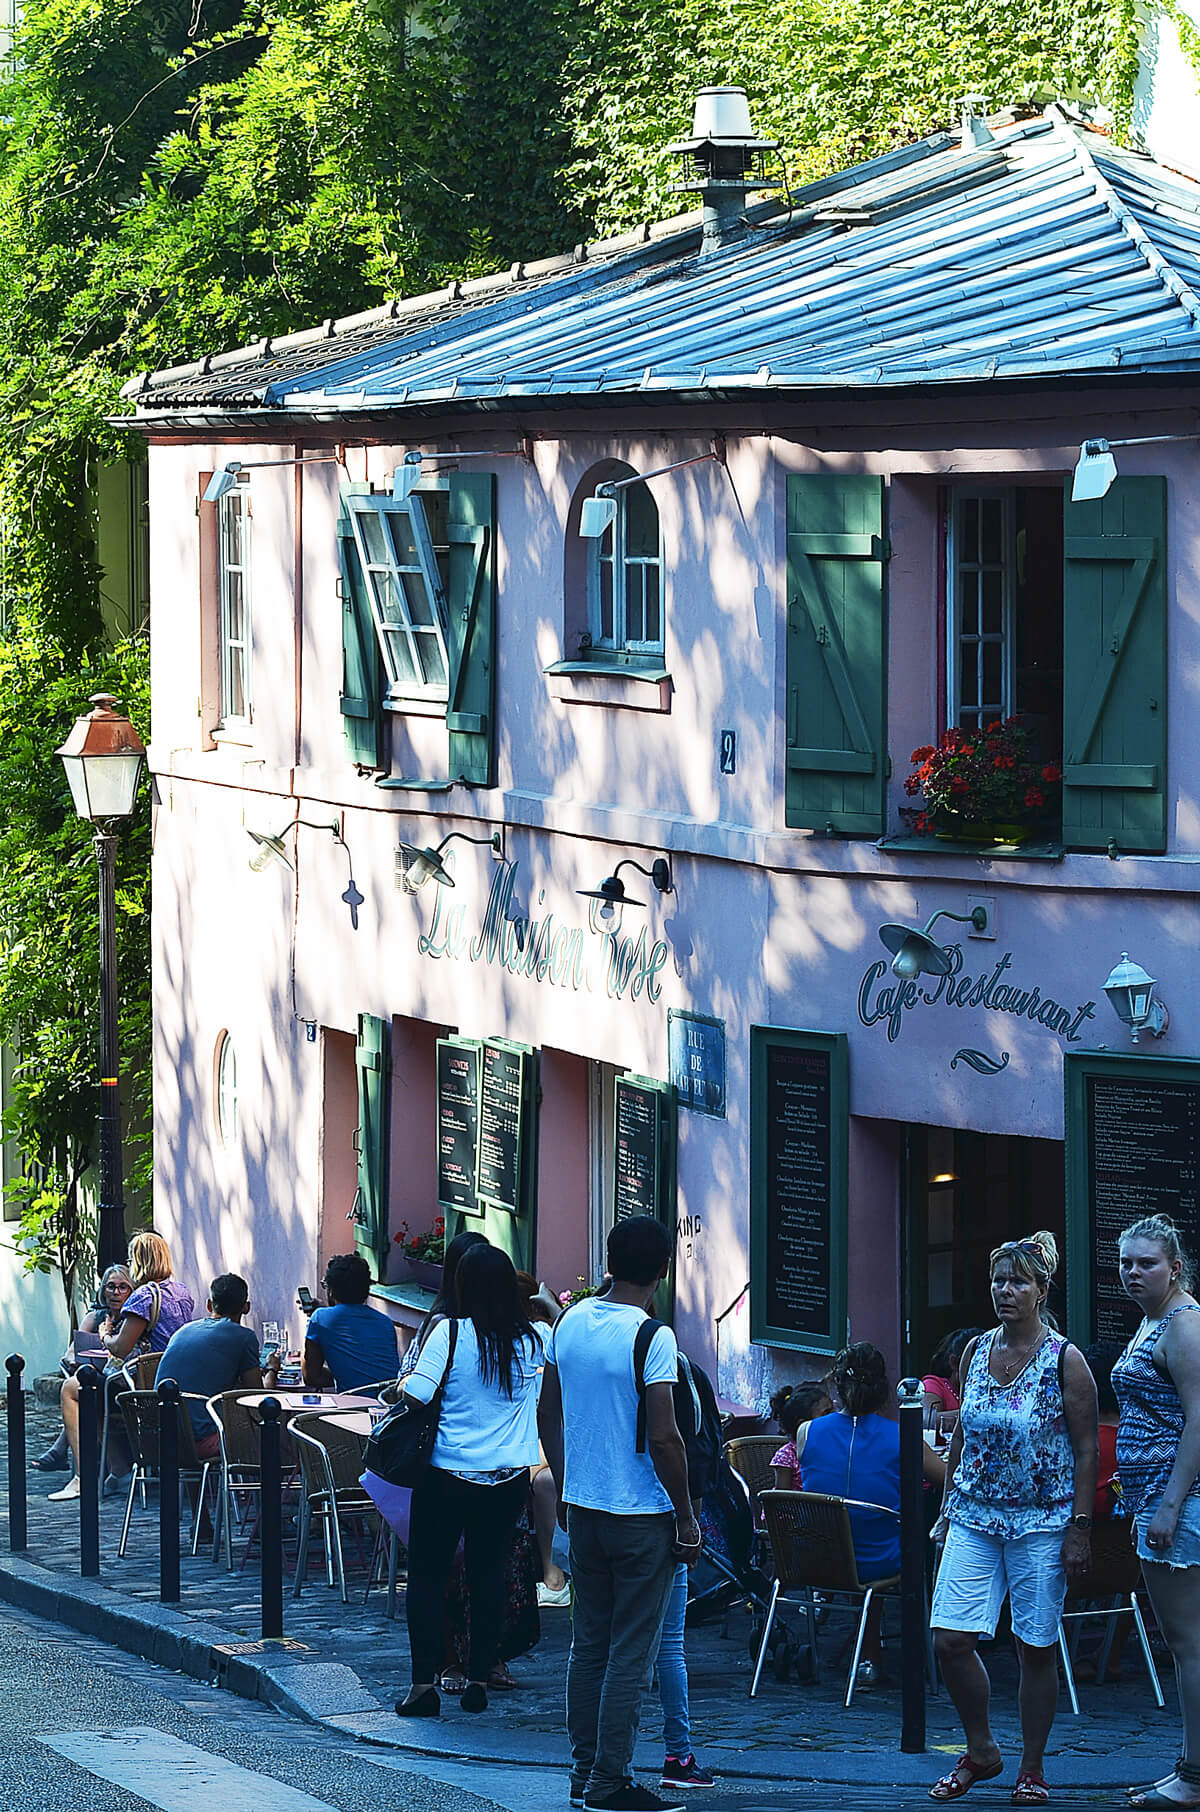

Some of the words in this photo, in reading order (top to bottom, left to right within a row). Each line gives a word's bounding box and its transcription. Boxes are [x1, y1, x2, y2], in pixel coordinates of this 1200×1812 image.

[724, 734, 732, 770] 2
[418, 849, 467, 960] La
[470, 860, 588, 990] Maison
[586, 878, 668, 1005] Rose
[923, 943, 1097, 1042] Restaurant
[307, 1026, 314, 1041] 2
[687, 1029, 705, 1050] RUE
[690, 1054, 702, 1072] DE
[672, 1069, 721, 1099] L'ABEUR
